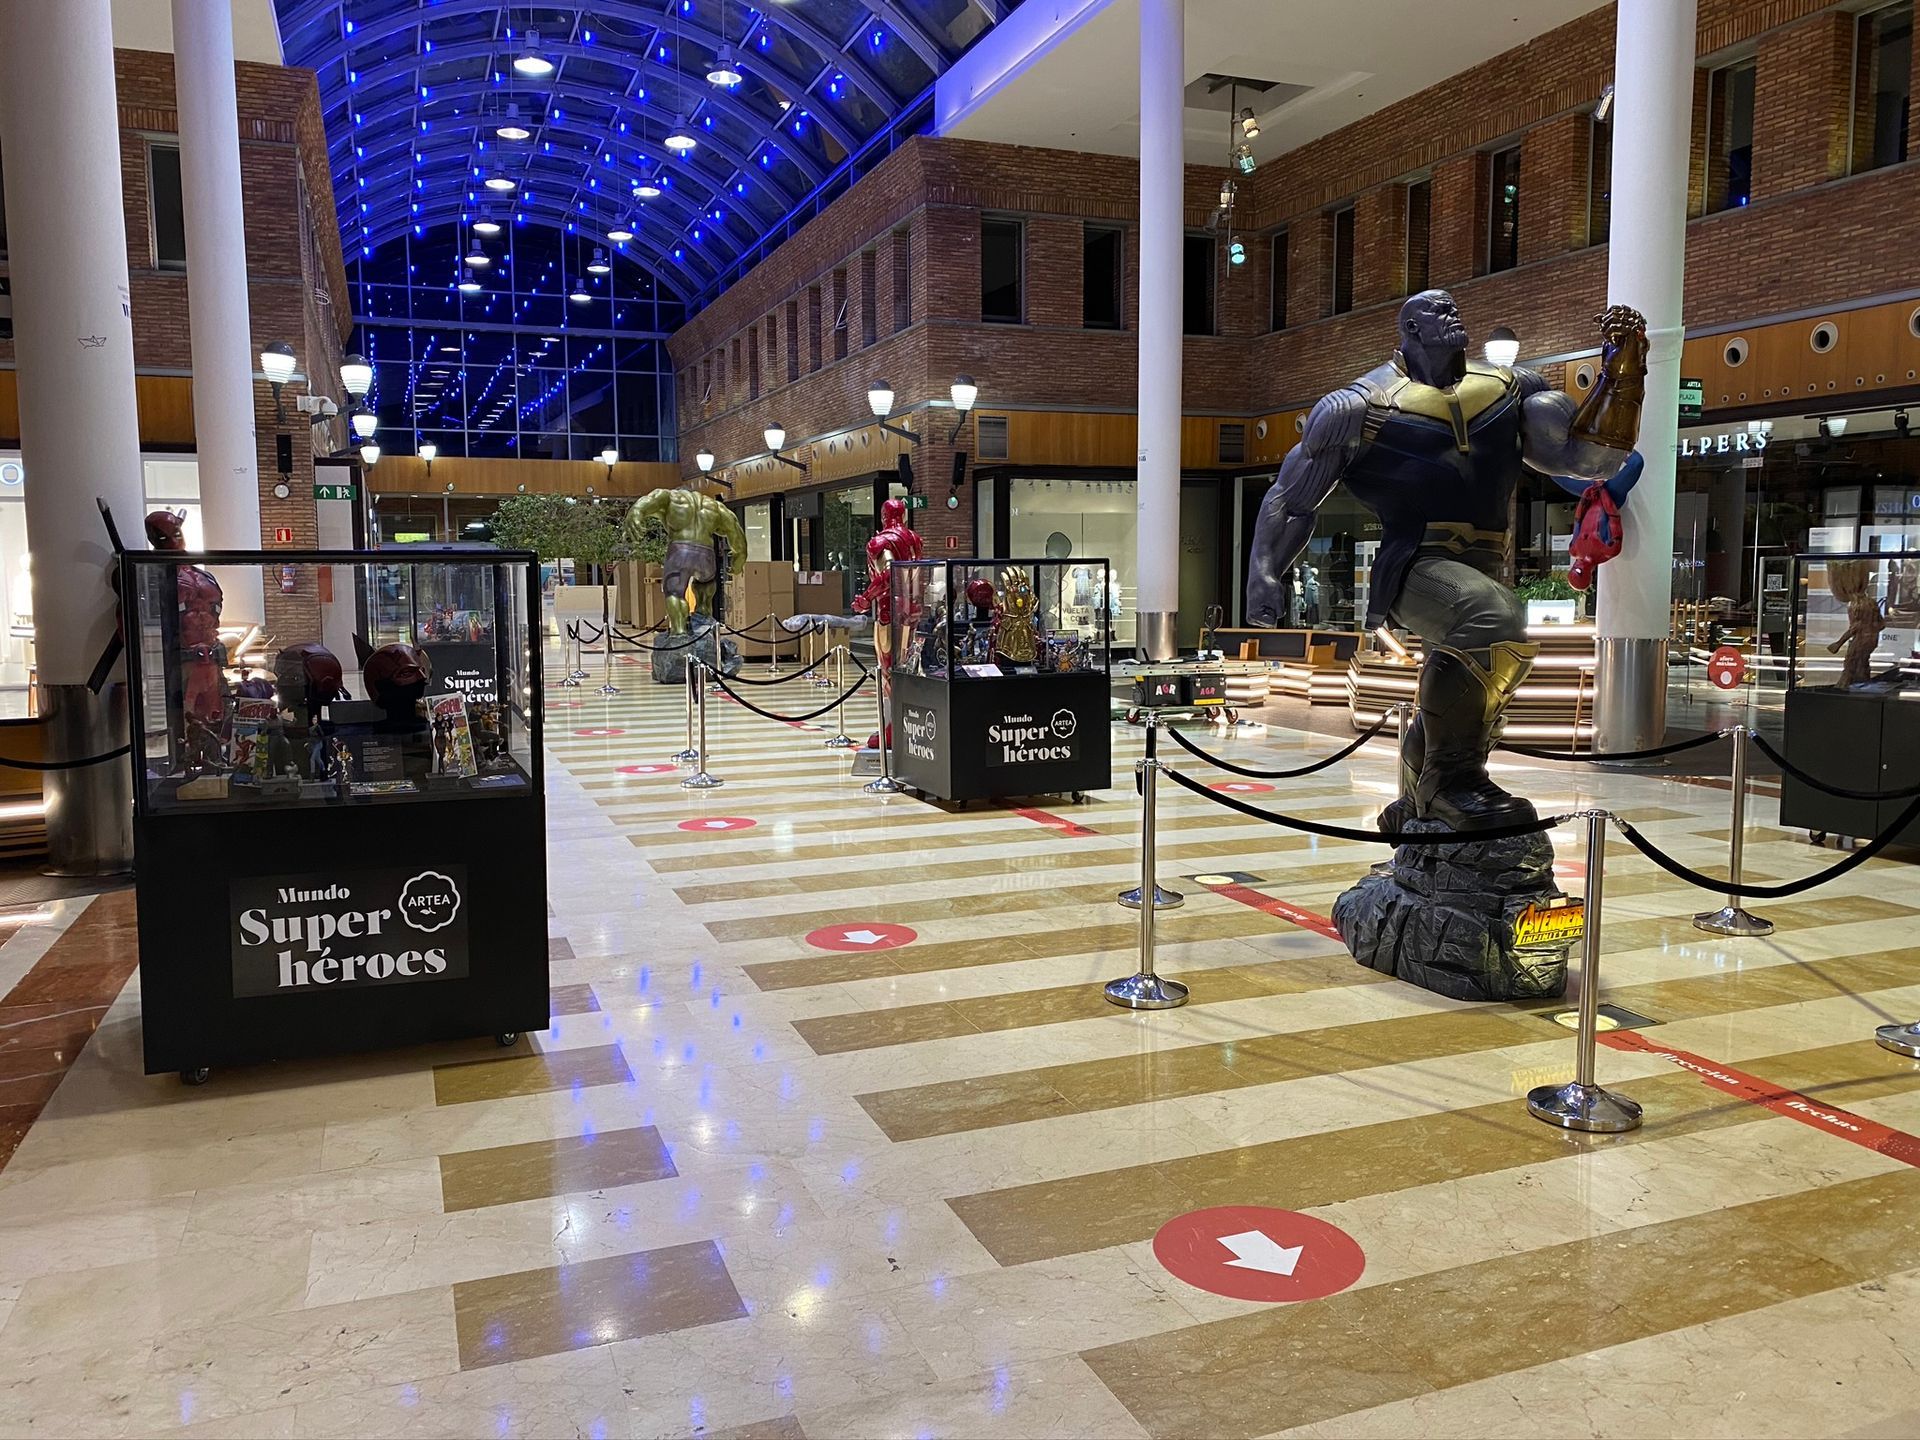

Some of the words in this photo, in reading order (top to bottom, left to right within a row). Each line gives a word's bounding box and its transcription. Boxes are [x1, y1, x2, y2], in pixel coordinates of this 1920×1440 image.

[444, 676, 493, 692] Super
[1155, 683, 1176, 696] AGR
[1200, 686, 1216, 695] AGR
[903, 716, 926, 739] Super
[1003, 713, 1033, 724] Mundo
[1055, 719, 1073, 727] ARTEA
[988, 725, 1049, 747] Super
[908, 737, 935, 761] héroes
[1003, 744, 1071, 763] héroes
[277, 884, 351, 904] Mundo
[407, 894, 451, 908] ARTEA
[239, 908, 392, 953] Super
[1521, 929, 1563, 943] INFINITY
[276, 946, 447, 988] héroes
[1653, 1051, 1740, 1085] dirección
[1784, 1101, 1862, 1132] flechas
